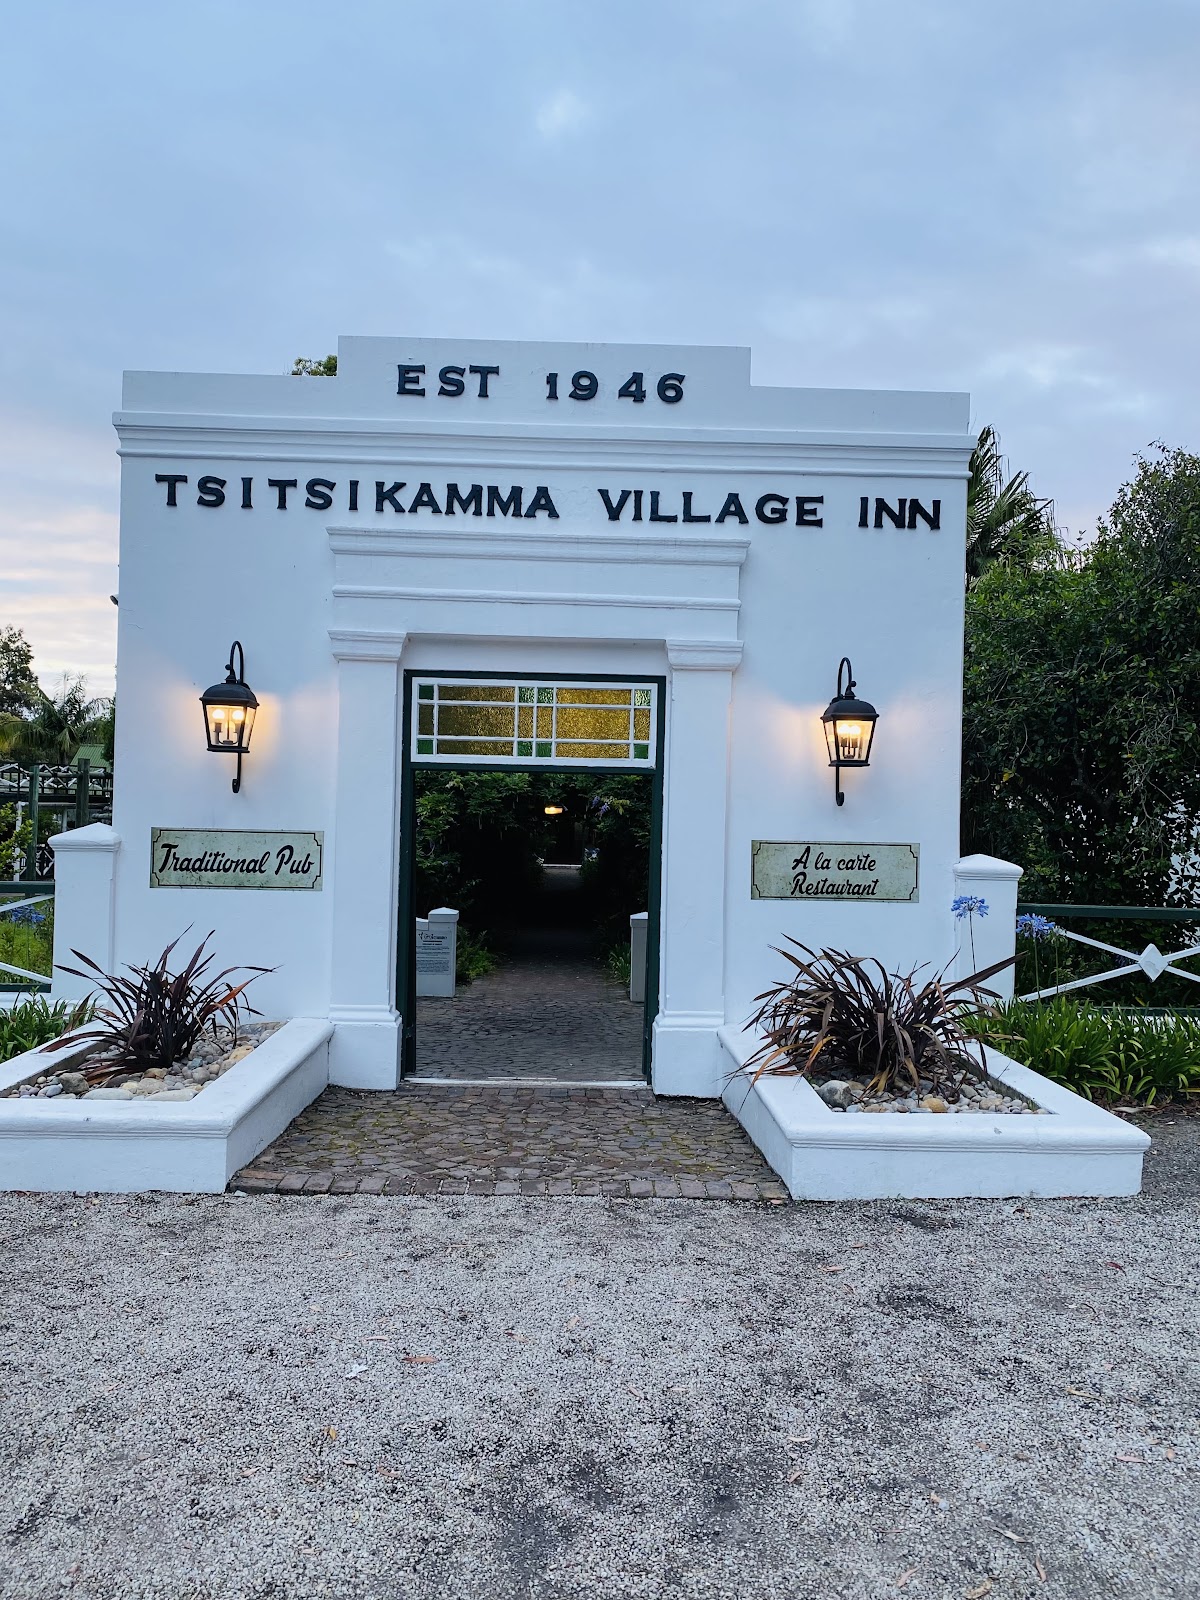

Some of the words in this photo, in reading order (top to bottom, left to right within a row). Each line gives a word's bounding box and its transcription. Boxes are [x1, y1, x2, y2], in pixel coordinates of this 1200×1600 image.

[397, 364, 500, 399] EST
[545, 370, 686, 403] 1946
[155, 473, 560, 519] TSITSIKAMMA
[597, 488, 825, 528] VILLAGE
[858, 496, 942, 531] INN
[158, 843, 271, 875] Traditional
[274, 844, 315, 876] Pub
[791, 845, 811, 871] A
[814, 852, 832, 871] la
[837, 853, 877, 872] carte
[790, 871, 880, 896] Restaurant
